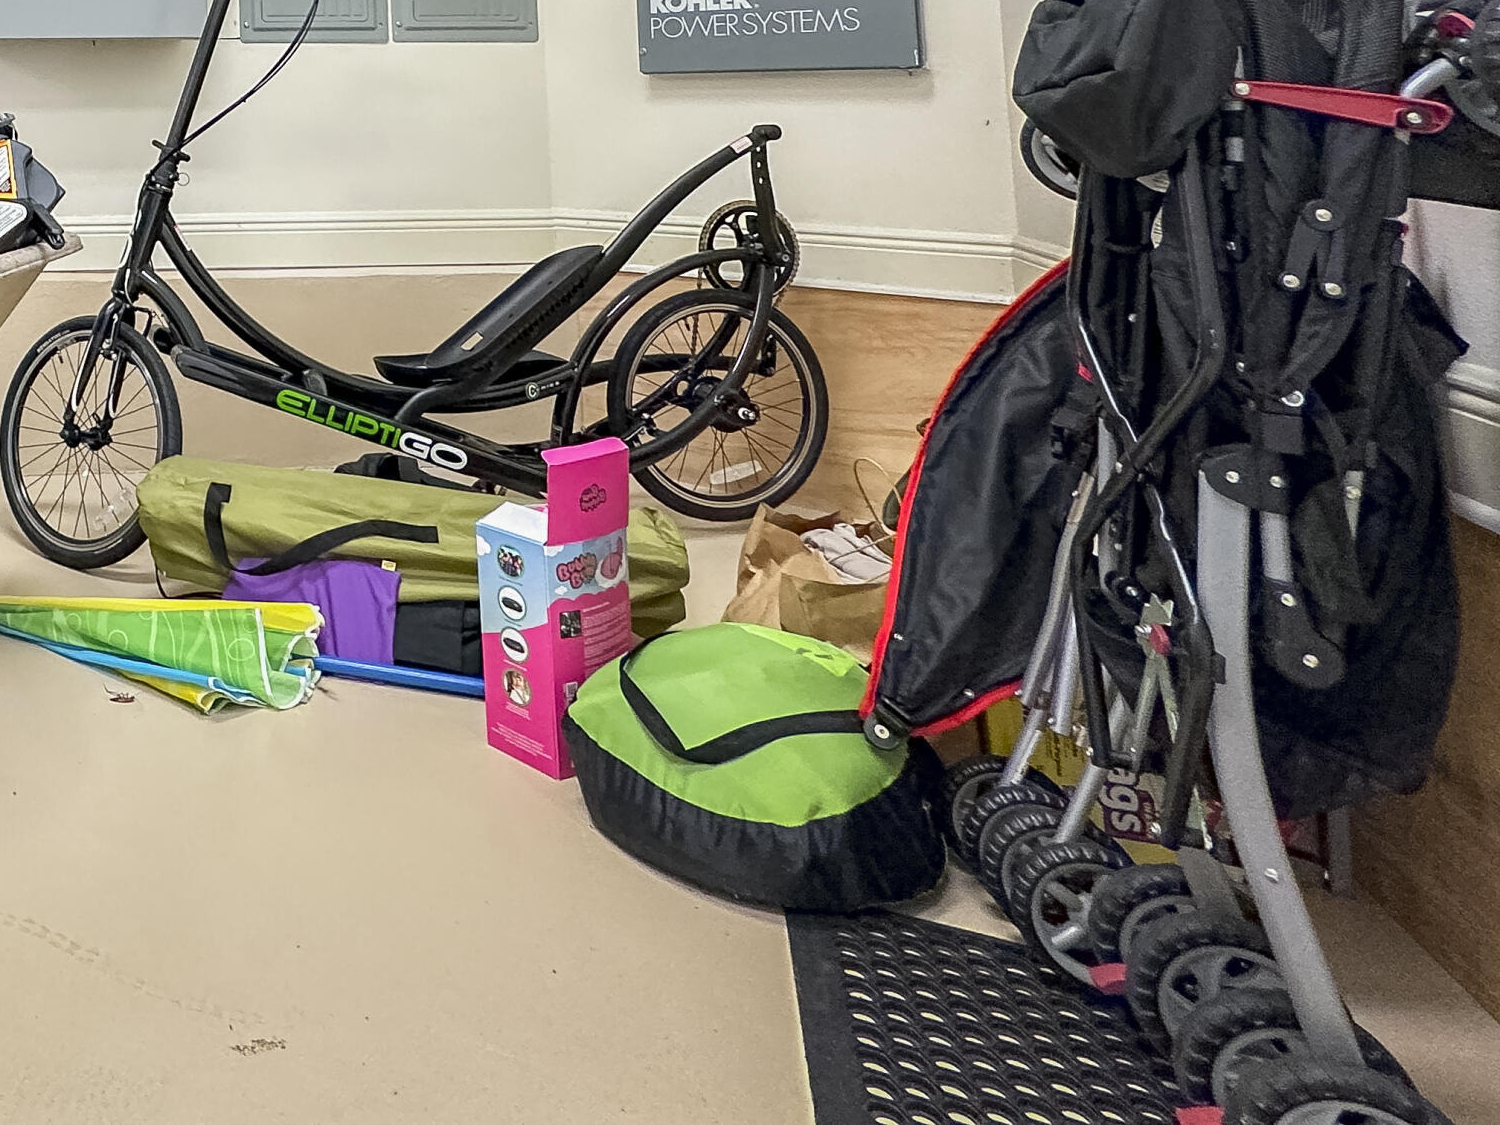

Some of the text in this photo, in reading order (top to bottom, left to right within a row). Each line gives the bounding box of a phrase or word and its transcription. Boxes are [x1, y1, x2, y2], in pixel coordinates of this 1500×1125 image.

[650, 7, 860, 39] POWER SYSTEMS
[276, 389, 468, 470] ELLIPTIGO
[1099, 768, 1142, 832] ags
